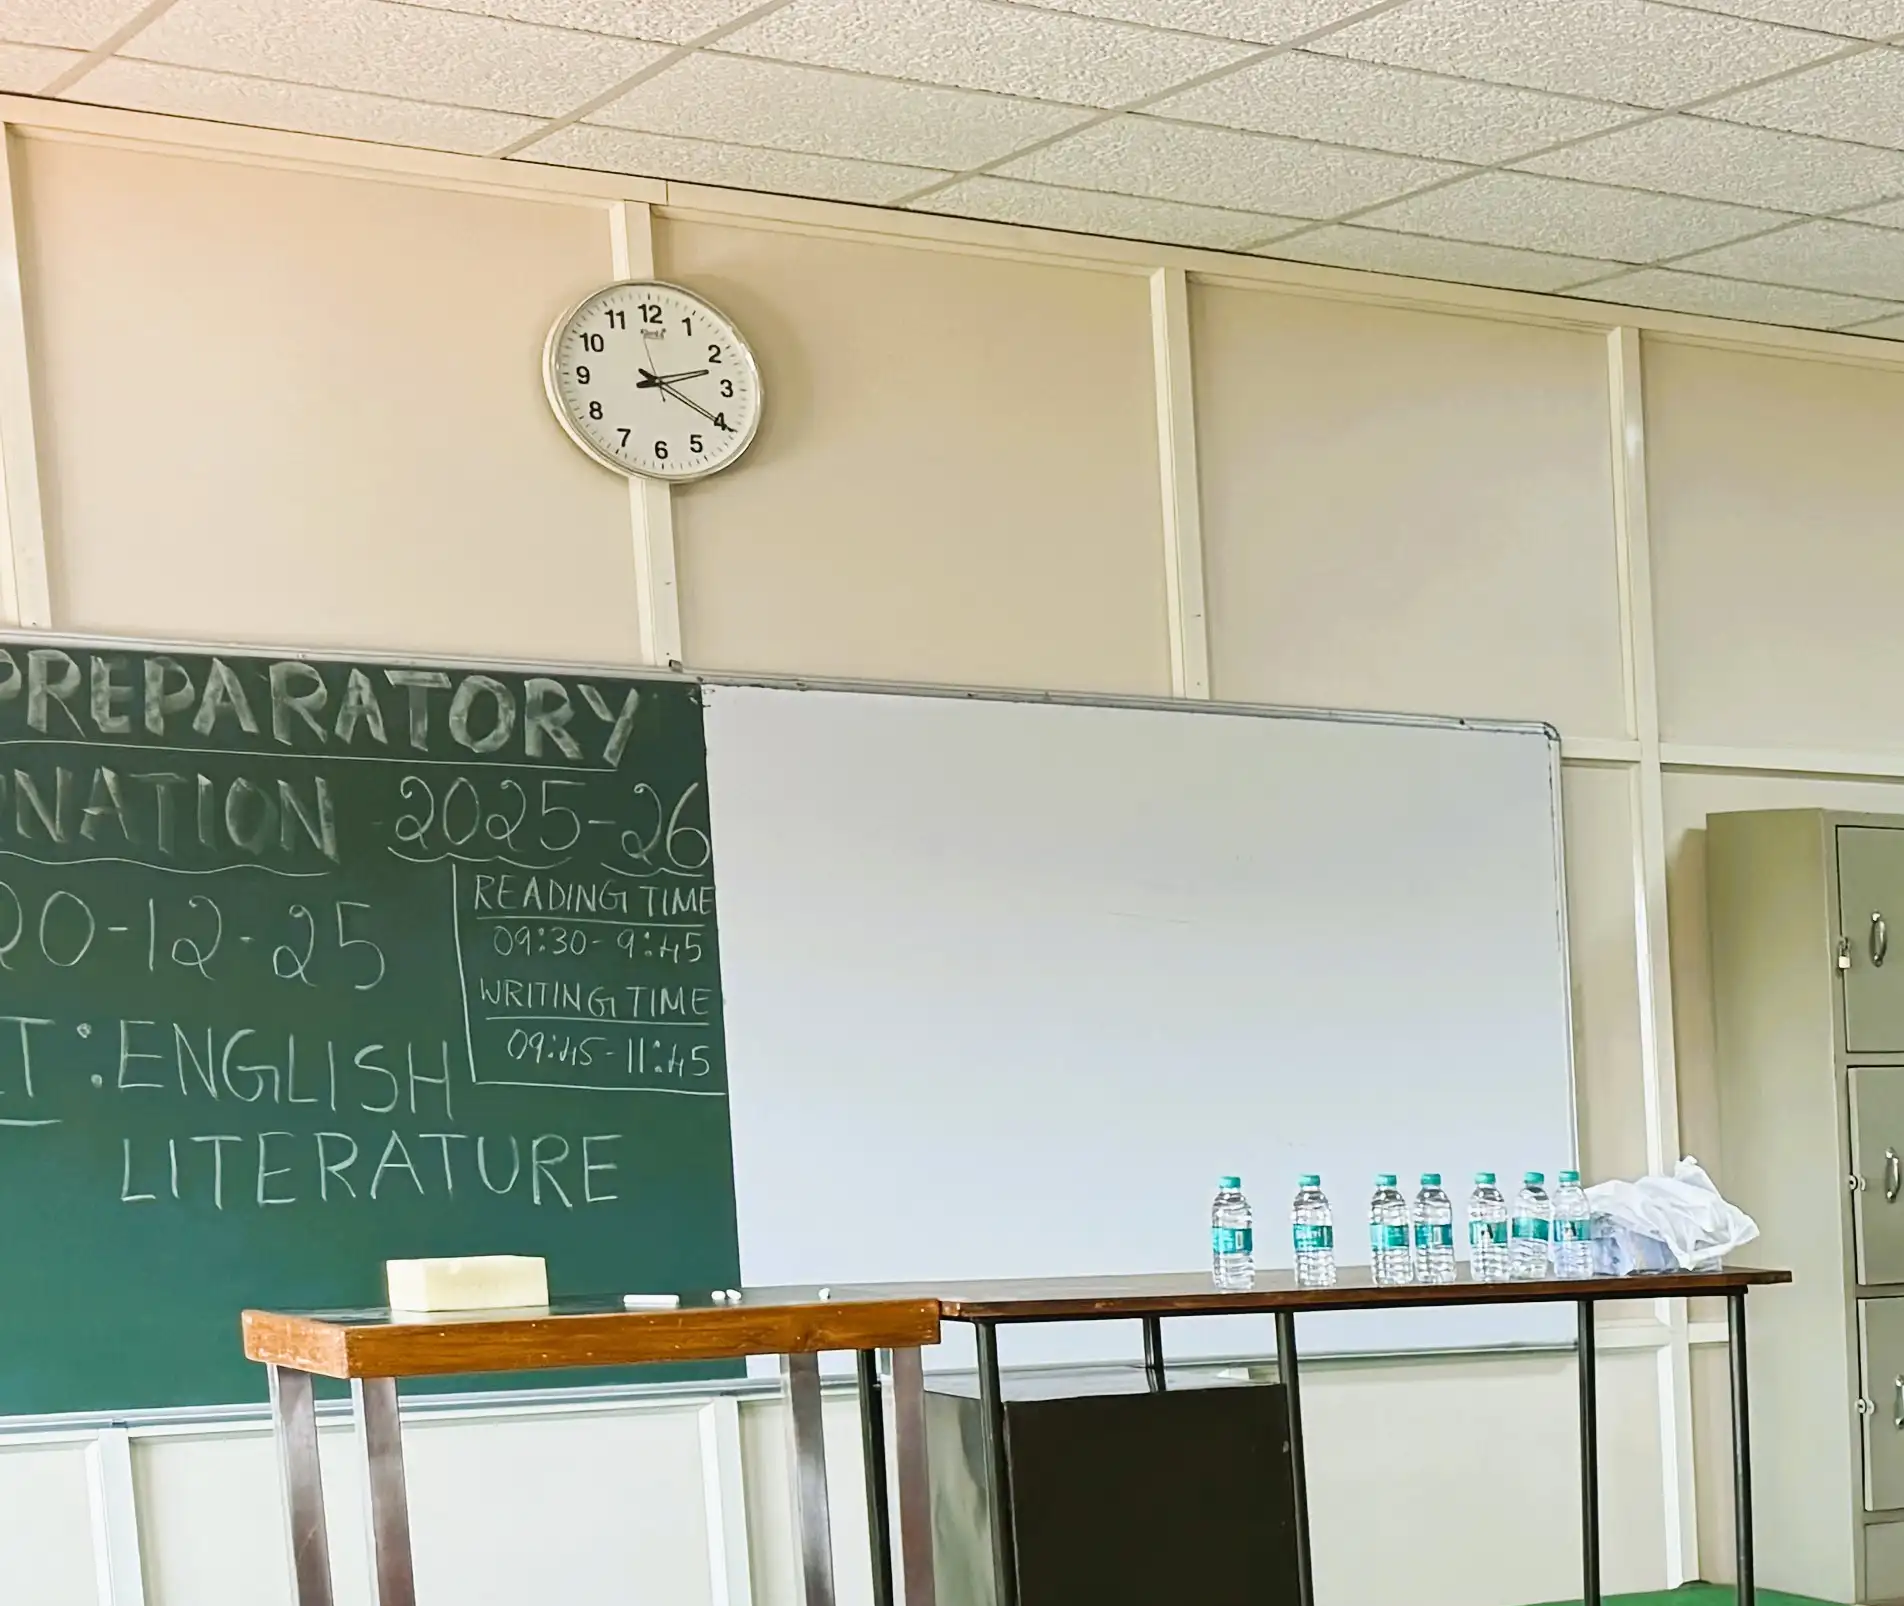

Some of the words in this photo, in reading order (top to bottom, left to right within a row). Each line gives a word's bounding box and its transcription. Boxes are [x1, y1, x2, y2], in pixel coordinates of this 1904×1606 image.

[604, 309, 626, 330] 11
[637, 303, 663, 324] 12
[682, 317, 693, 337] 1
[579, 331, 605, 353] 10
[708, 344, 722, 364] 2
[576, 365, 591, 385] 9
[719, 378, 734, 398] 3
[588, 400, 604, 421] 8
[713, 411, 728, 431] 4
[616, 427, 632, 448] 7
[689, 434, 703, 454] 5
[654, 440, 669, 460] 6
[0, 764, 341, 863] NATION
[395, 775, 711, 869] 2025-26
[474, 875, 628, 914] READING
[639, 885, 715, 918] TIME
[480, 977, 616, 1018] WRITING
[625, 986, 712, 1018] TIME
[117, 1019, 453, 1120] ENGLISH
[121, 1130, 624, 1209] LITERATURE
